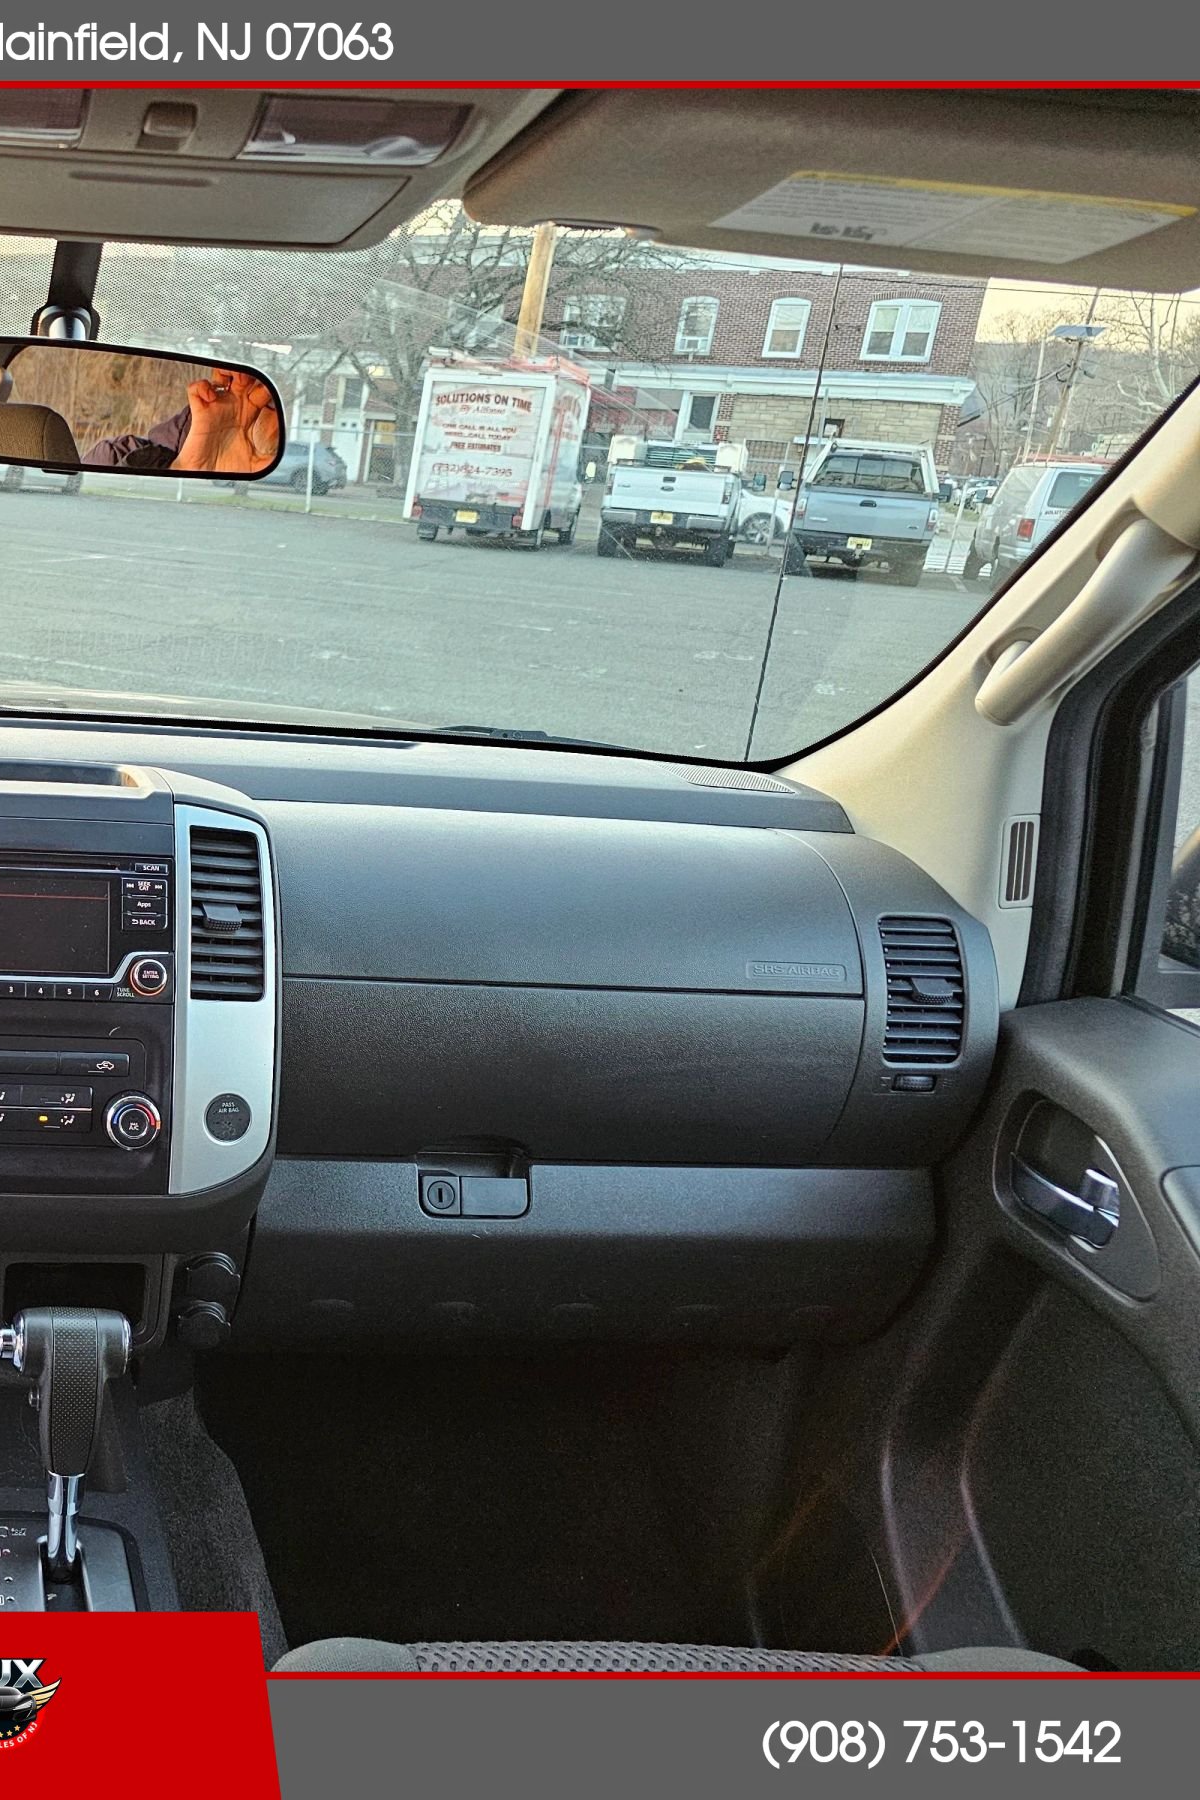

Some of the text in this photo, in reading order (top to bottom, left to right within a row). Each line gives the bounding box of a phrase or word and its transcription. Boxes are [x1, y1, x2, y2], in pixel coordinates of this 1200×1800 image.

[435, 392, 533, 413] SOLUTIONS ON TIME
[486, 425, 501, 433] ALL
[753, 964, 840, 977] SRS AIRBAG
